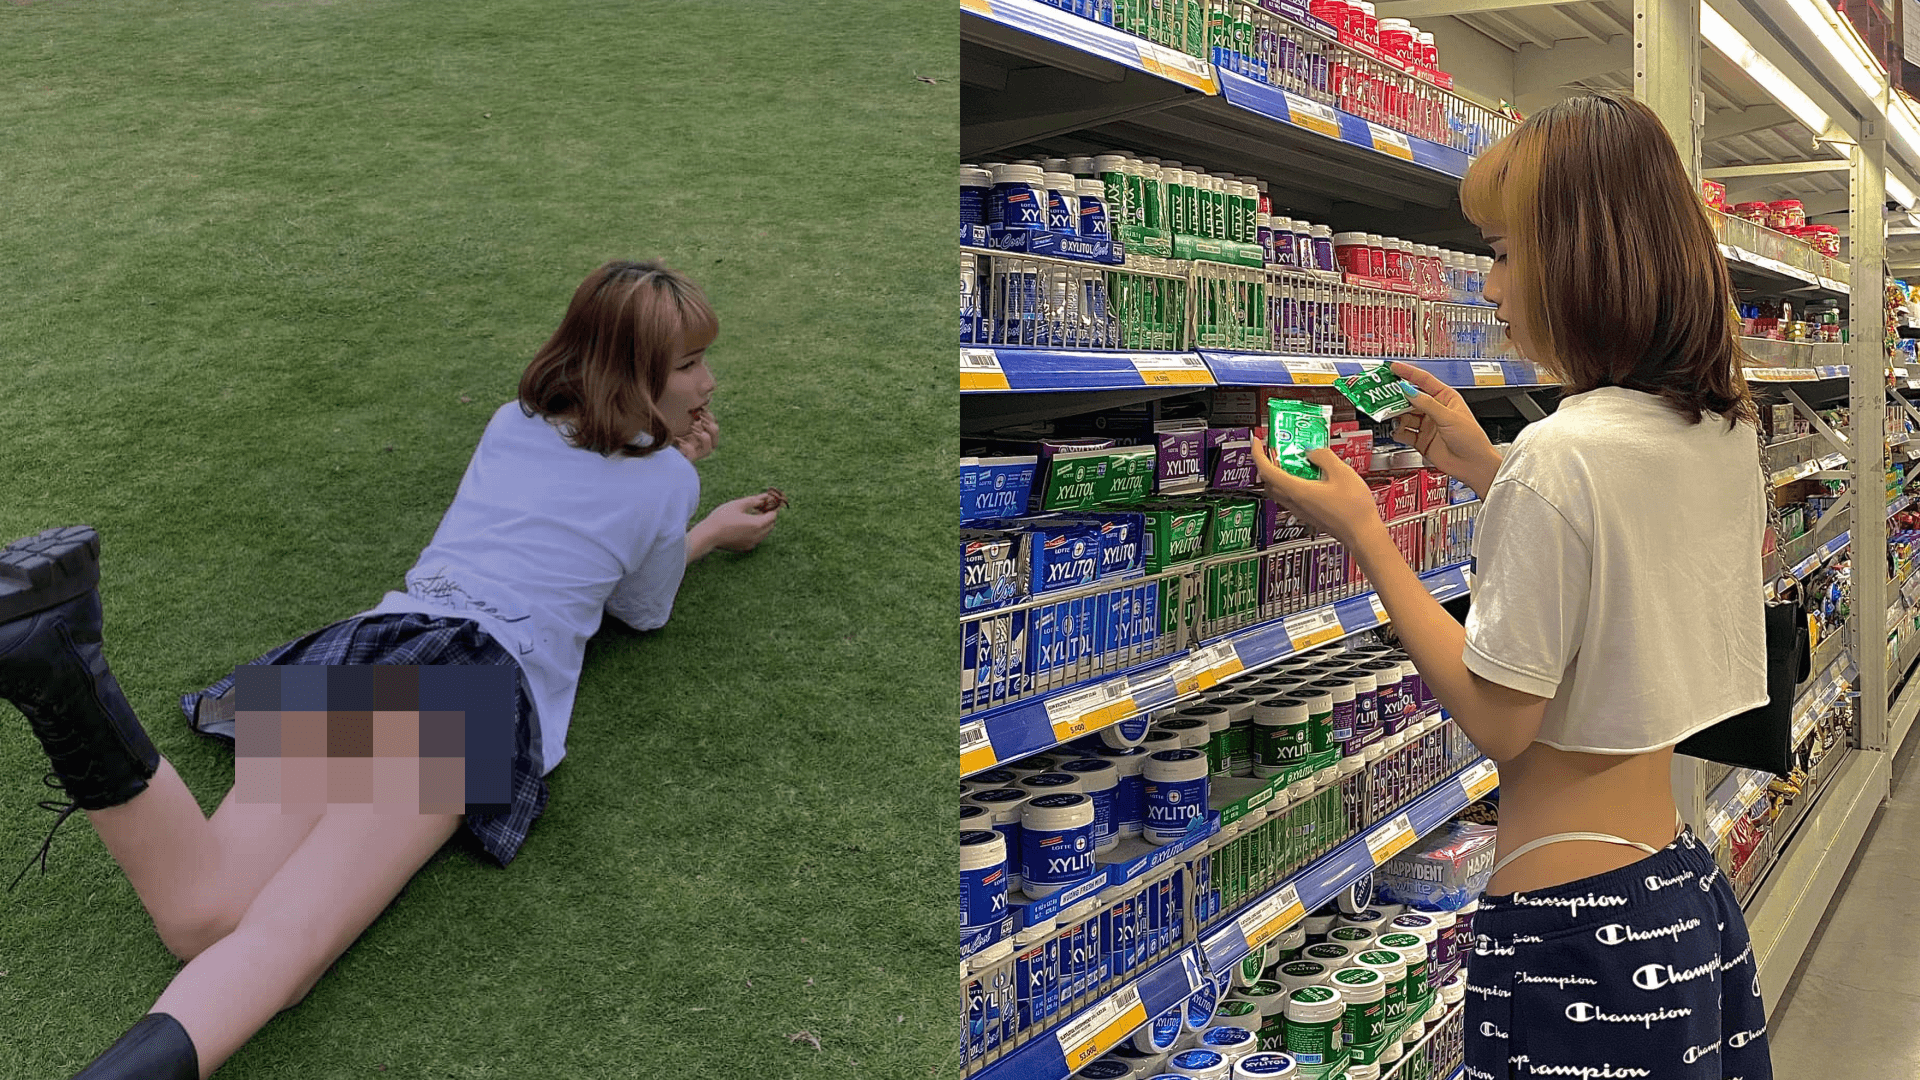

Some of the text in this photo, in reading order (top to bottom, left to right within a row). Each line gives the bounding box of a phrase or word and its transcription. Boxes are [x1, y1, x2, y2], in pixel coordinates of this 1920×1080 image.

[1068, 242, 1093, 254] XYLITOL
[1166, 460, 1200, 476] XYLITOL
[1221, 467, 1251, 482] XYLITOL
[1056, 483, 1095, 500] XYLITOL
[1111, 476, 1143, 492] XYLITOL
[976, 490, 1016, 508] XYLITOL
[1220, 528, 1251, 546] XYLITOL
[1170, 536, 1202, 556] XYLITOL
[966, 558, 1017, 586] XYLITOL
[1148, 803, 1202, 820] XYLITOL
[1386, 860, 1444, 882] HAPPYDENT
[1645, 870, 1694, 891] Champion
[1595, 918, 1700, 945] Champion
[1192, 994, 1213, 1012] XYLITOL
[1155, 1017, 1180, 1027] XYLITOL
[1565, 1002, 1692, 1029] Champion
[1079, 1045, 1097, 1061] 53.000
[1245, 1059, 1286, 1068] XYLITOL
